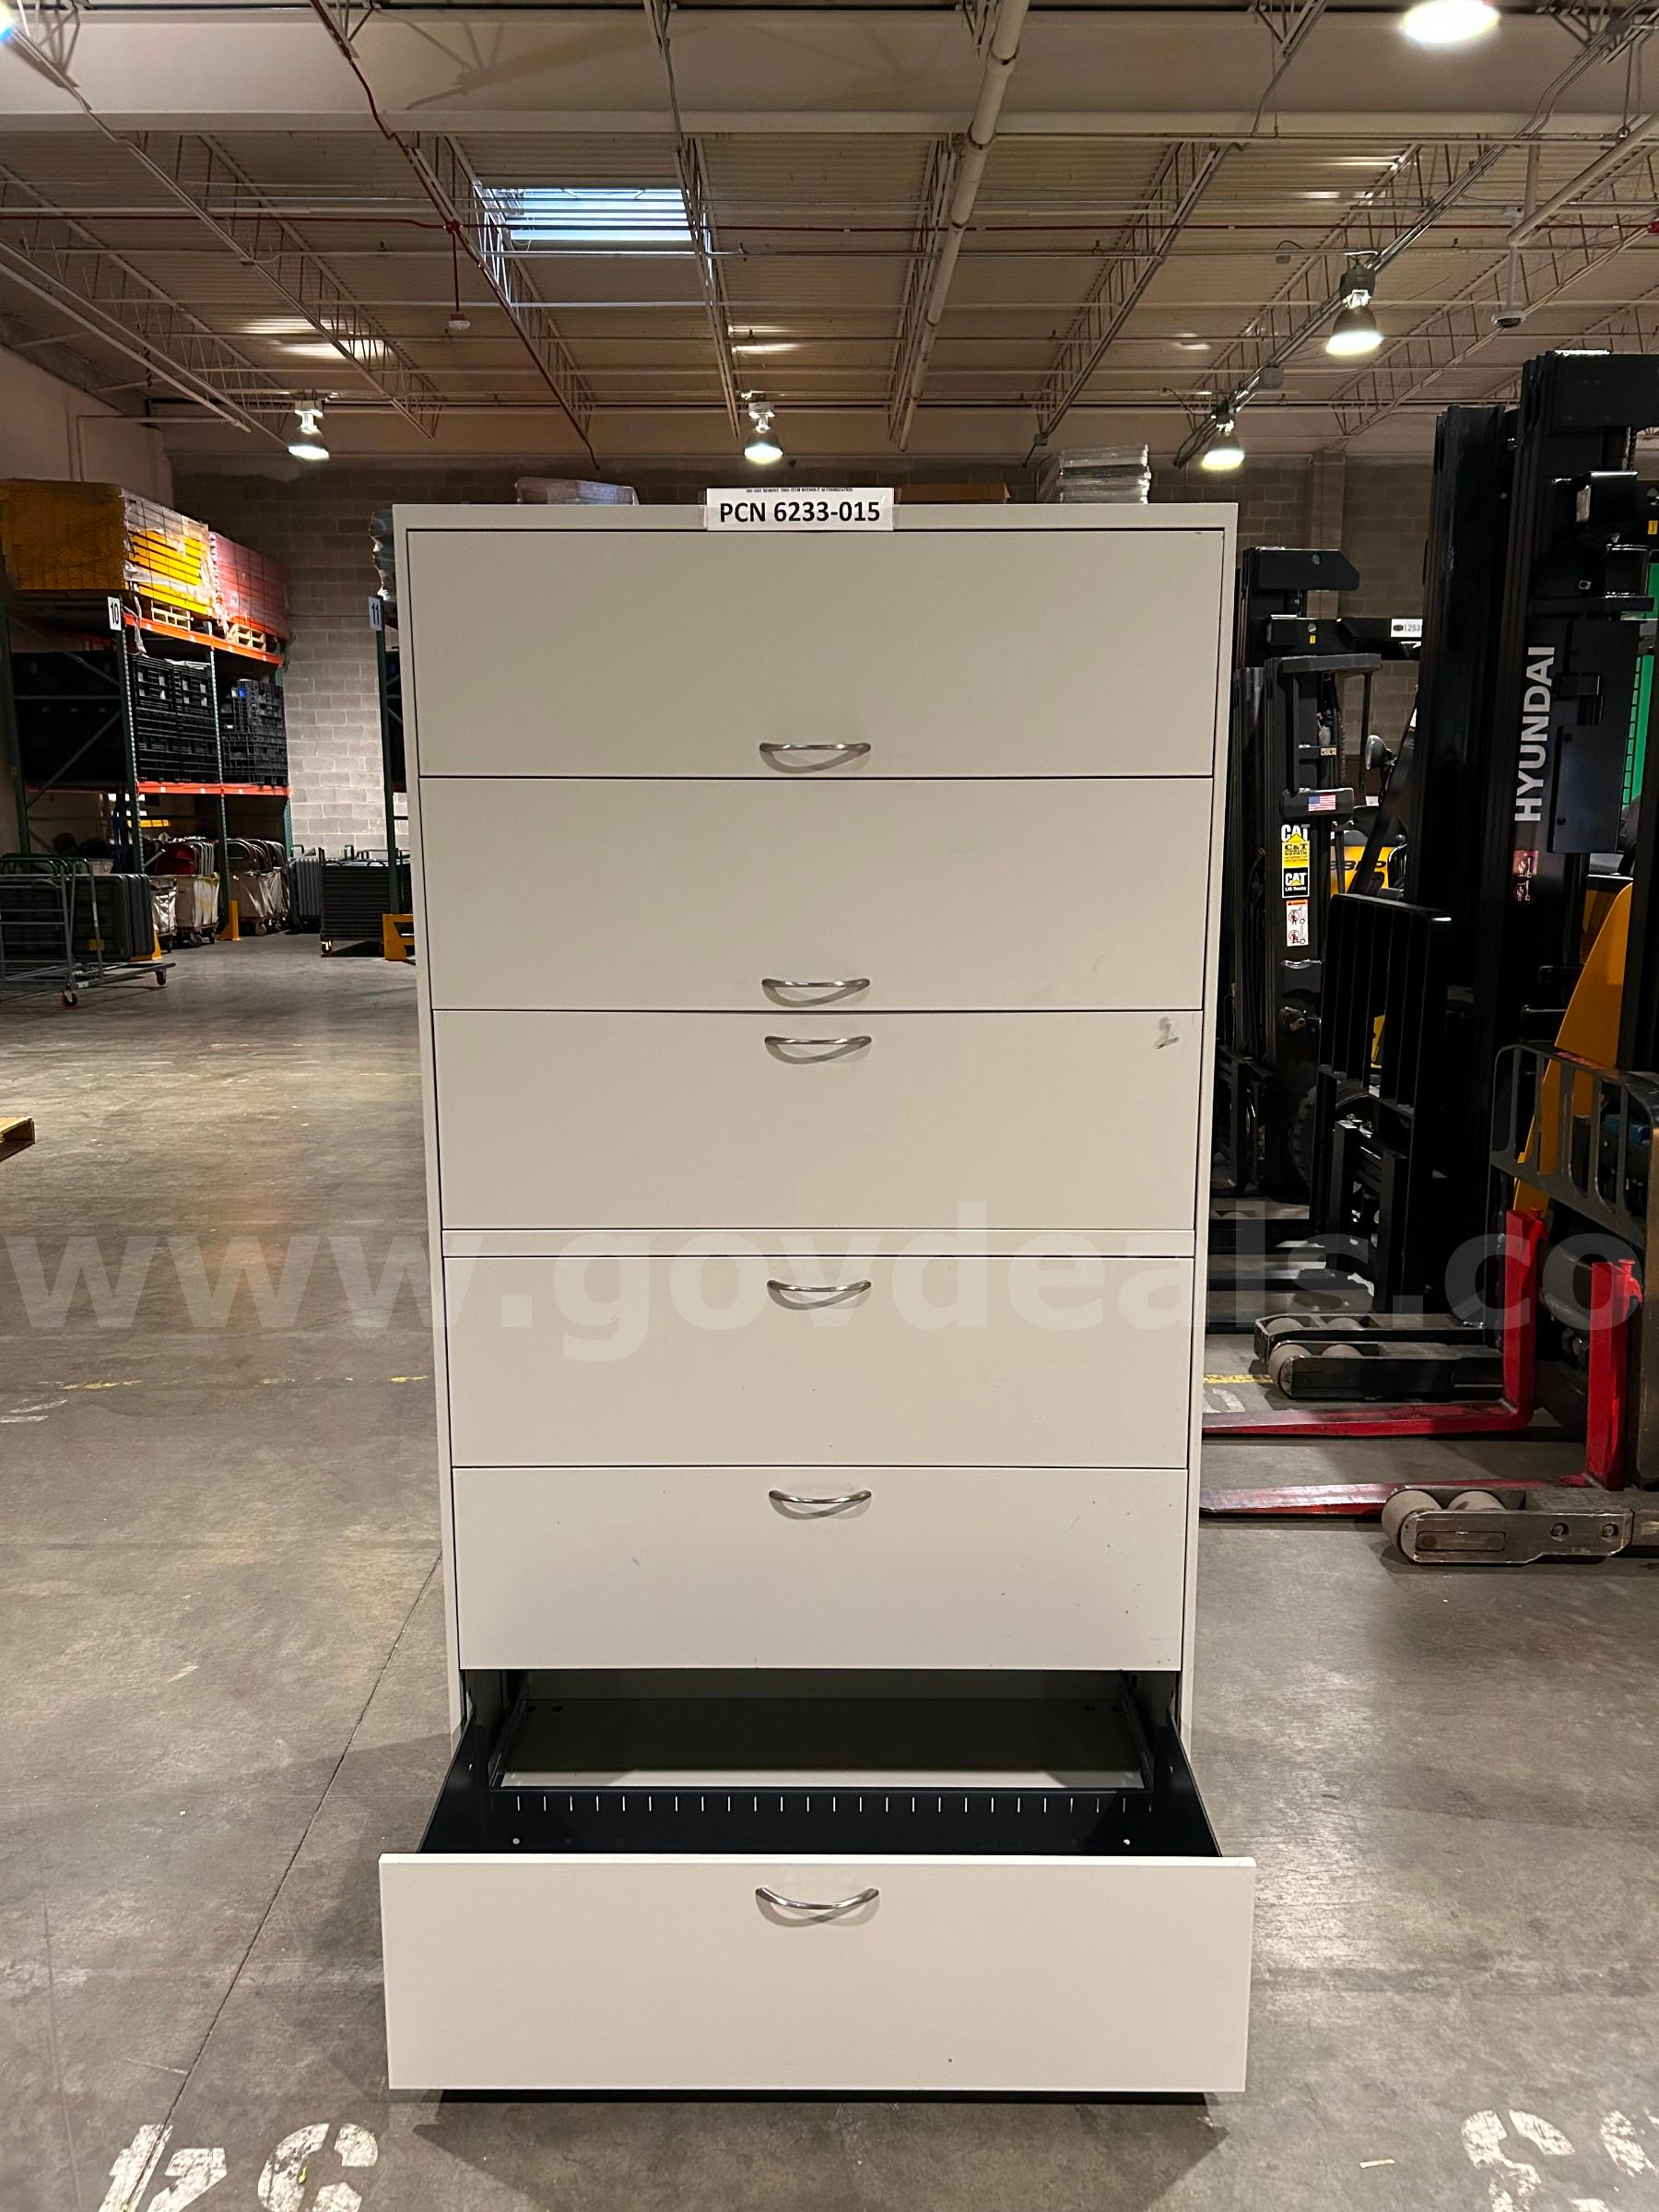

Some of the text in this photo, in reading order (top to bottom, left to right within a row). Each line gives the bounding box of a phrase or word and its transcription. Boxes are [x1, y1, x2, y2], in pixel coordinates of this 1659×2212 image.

[720, 501, 880, 523] PCN 6233-015
[111, 602, 119, 624] 10
[371, 603, 380, 624] 11
[1514, 646, 1556, 822] HYUNDAI
[1281, 824, 1310, 841] CAT
[1285, 873, 1307, 886] CAT
